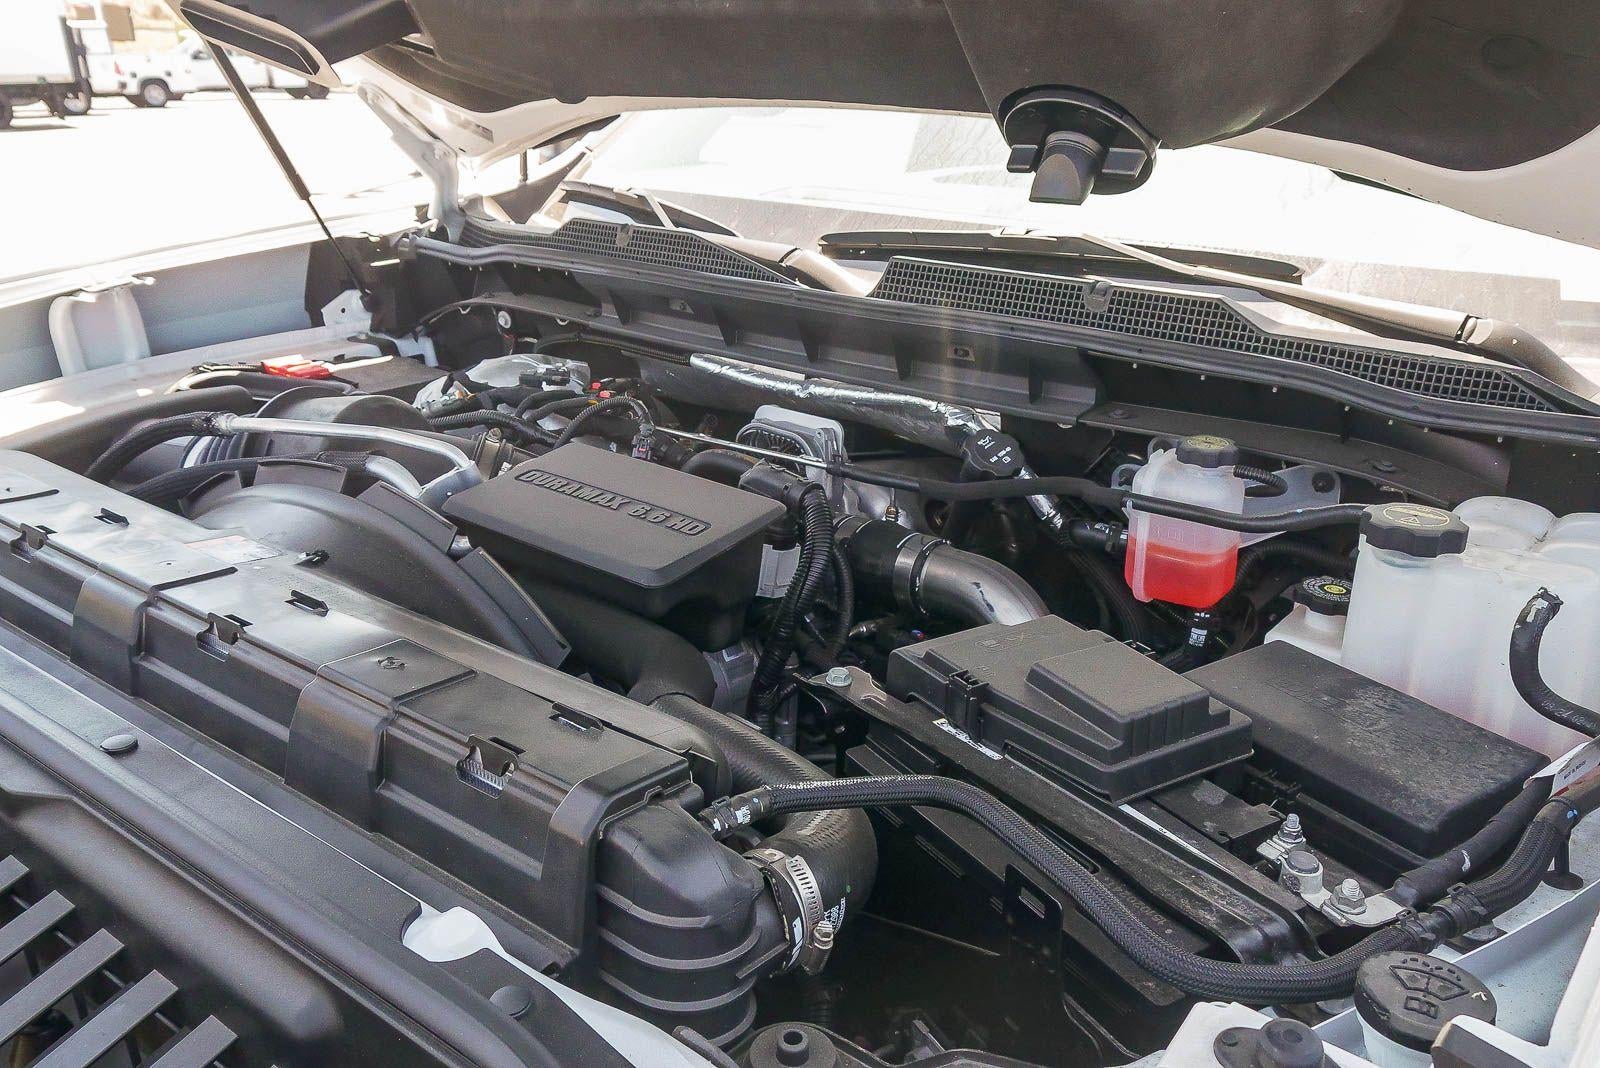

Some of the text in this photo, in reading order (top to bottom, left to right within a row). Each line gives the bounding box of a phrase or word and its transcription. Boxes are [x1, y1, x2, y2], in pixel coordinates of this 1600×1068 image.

[518, 471, 706, 536] DURAMAX 6.6 HD
